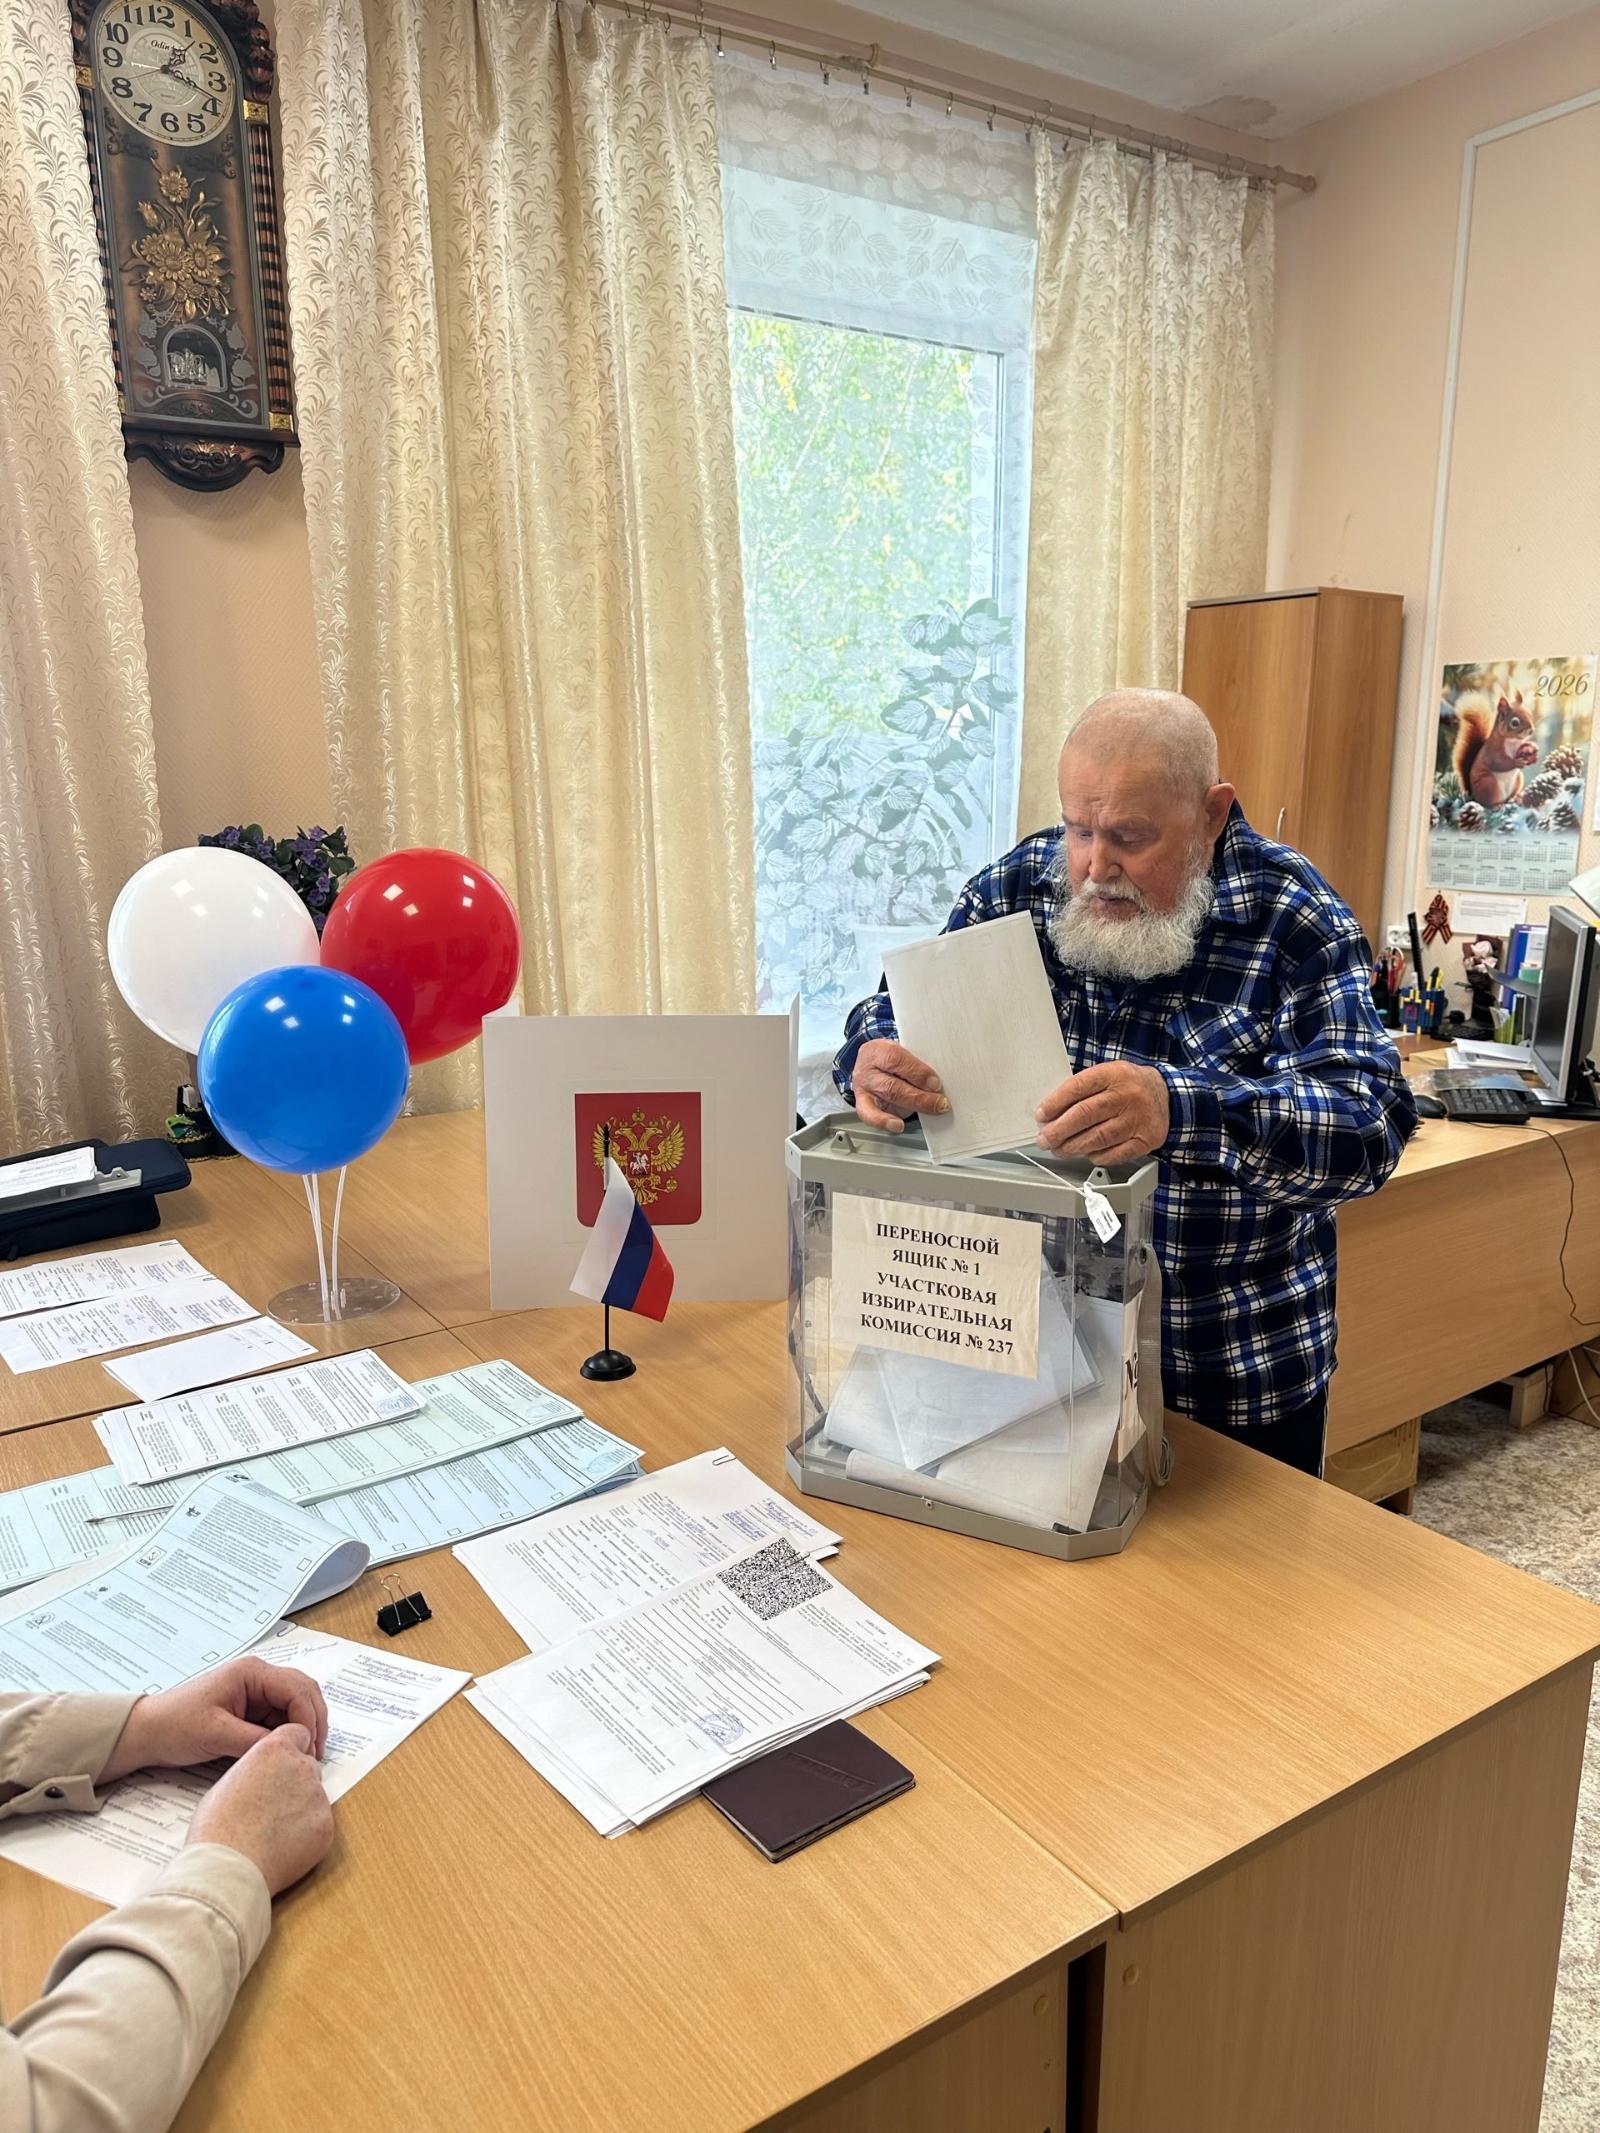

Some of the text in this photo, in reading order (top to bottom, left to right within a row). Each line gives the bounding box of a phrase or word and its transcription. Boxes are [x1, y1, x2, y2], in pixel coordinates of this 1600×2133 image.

[122, 4, 143, 25] 11
[148, 4, 174, 28] 12
[105, 22, 129, 44] 10
[184, 19, 192, 37] 1
[102, 46, 122, 67] 9
[198, 41, 218, 63] 2
[111, 76, 132, 98] 8
[207, 71, 227, 92] 3
[133, 101, 152, 121] 7
[201, 97, 221, 117] 4
[160, 112, 179, 132] 6
[187, 113, 205, 133] 5
[1534, 673, 1589, 698] 2026
[876, 1223, 1000, 1256] ПЕРЕНОСНОЙ
[892, 1249, 981, 1276] ЯЩИК № 1
[877, 1271, 997, 1306] УЧАСТКОВАЯ
[861, 1291, 1013, 1332] ИЗБИРАТЕЛЬНАЯ
[860, 1314, 1014, 1356] КОМИССИЯ № 237
